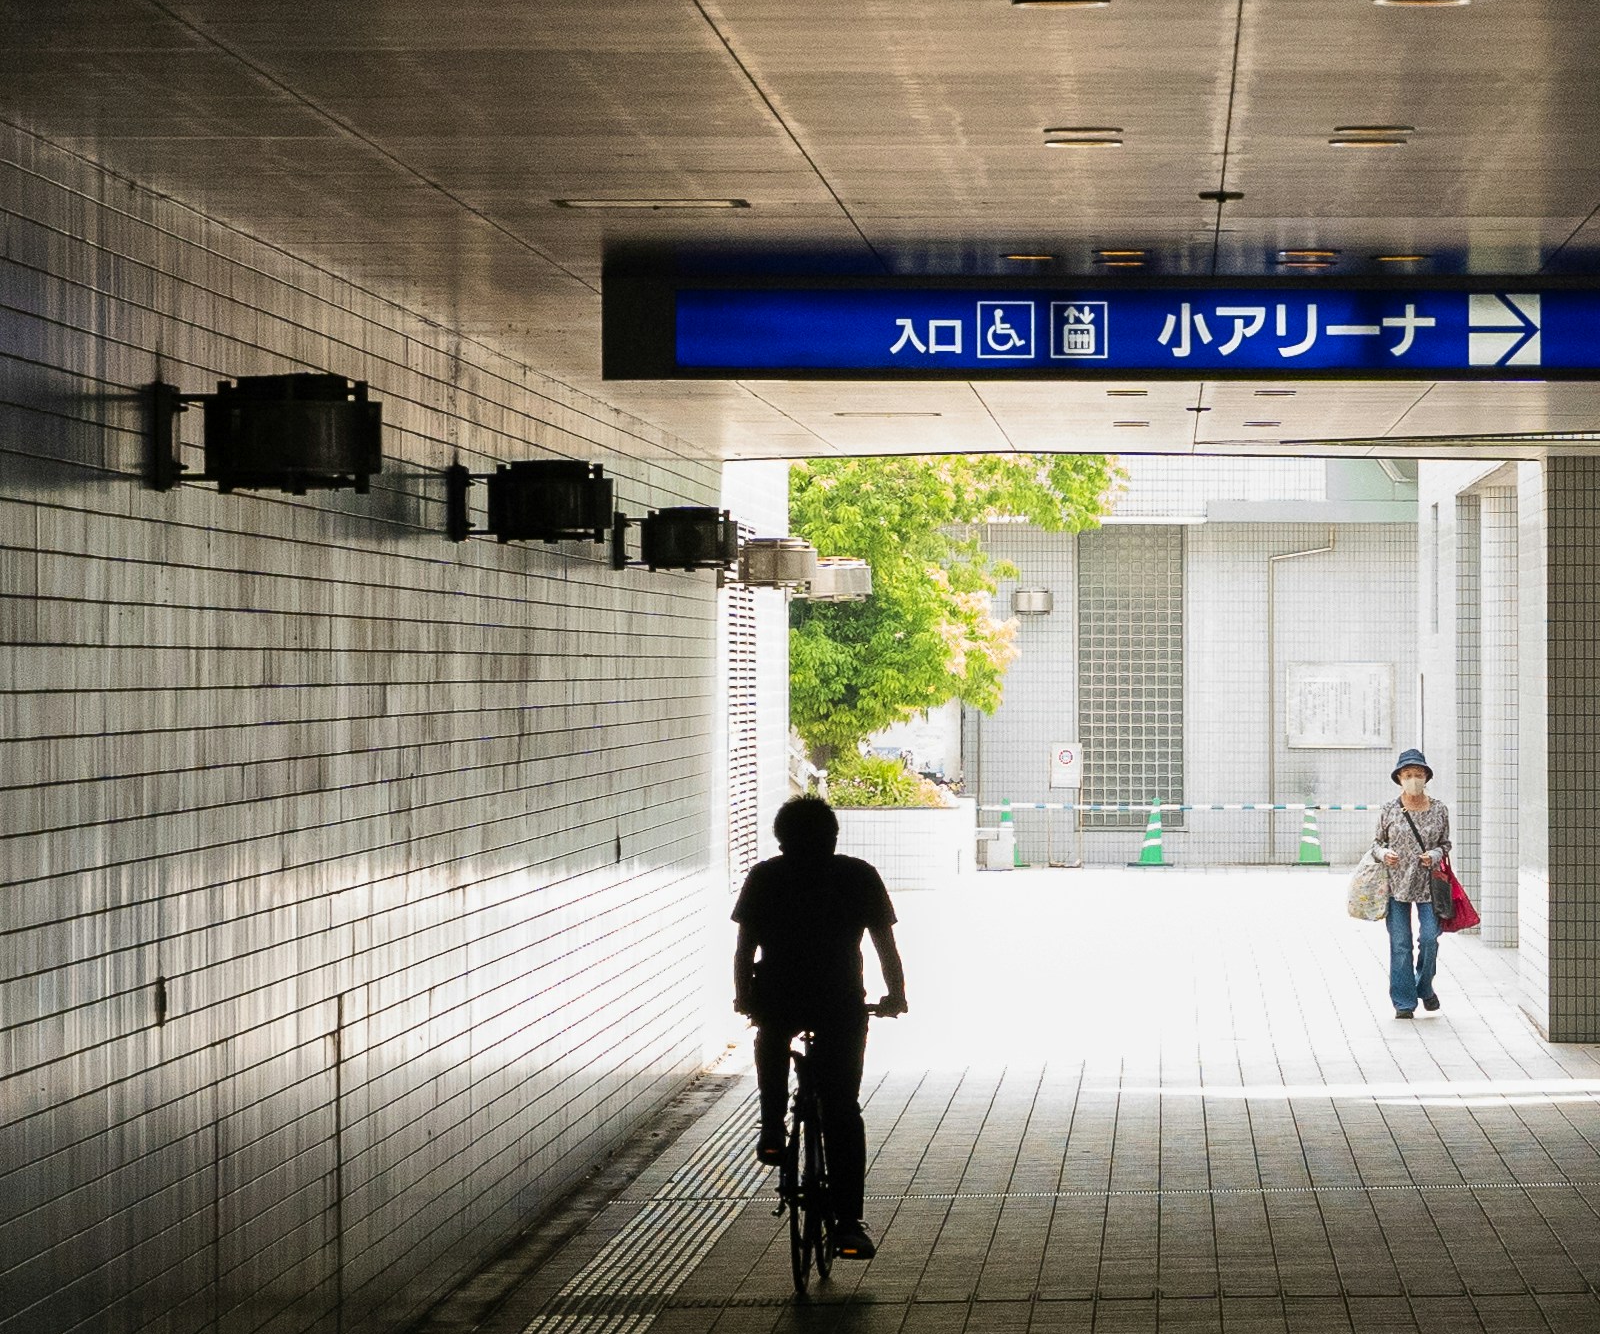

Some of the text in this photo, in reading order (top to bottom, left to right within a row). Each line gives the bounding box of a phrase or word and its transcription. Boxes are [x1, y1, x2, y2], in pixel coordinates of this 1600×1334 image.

[889, 302, 1436, 358] 入口 小アリーナ
